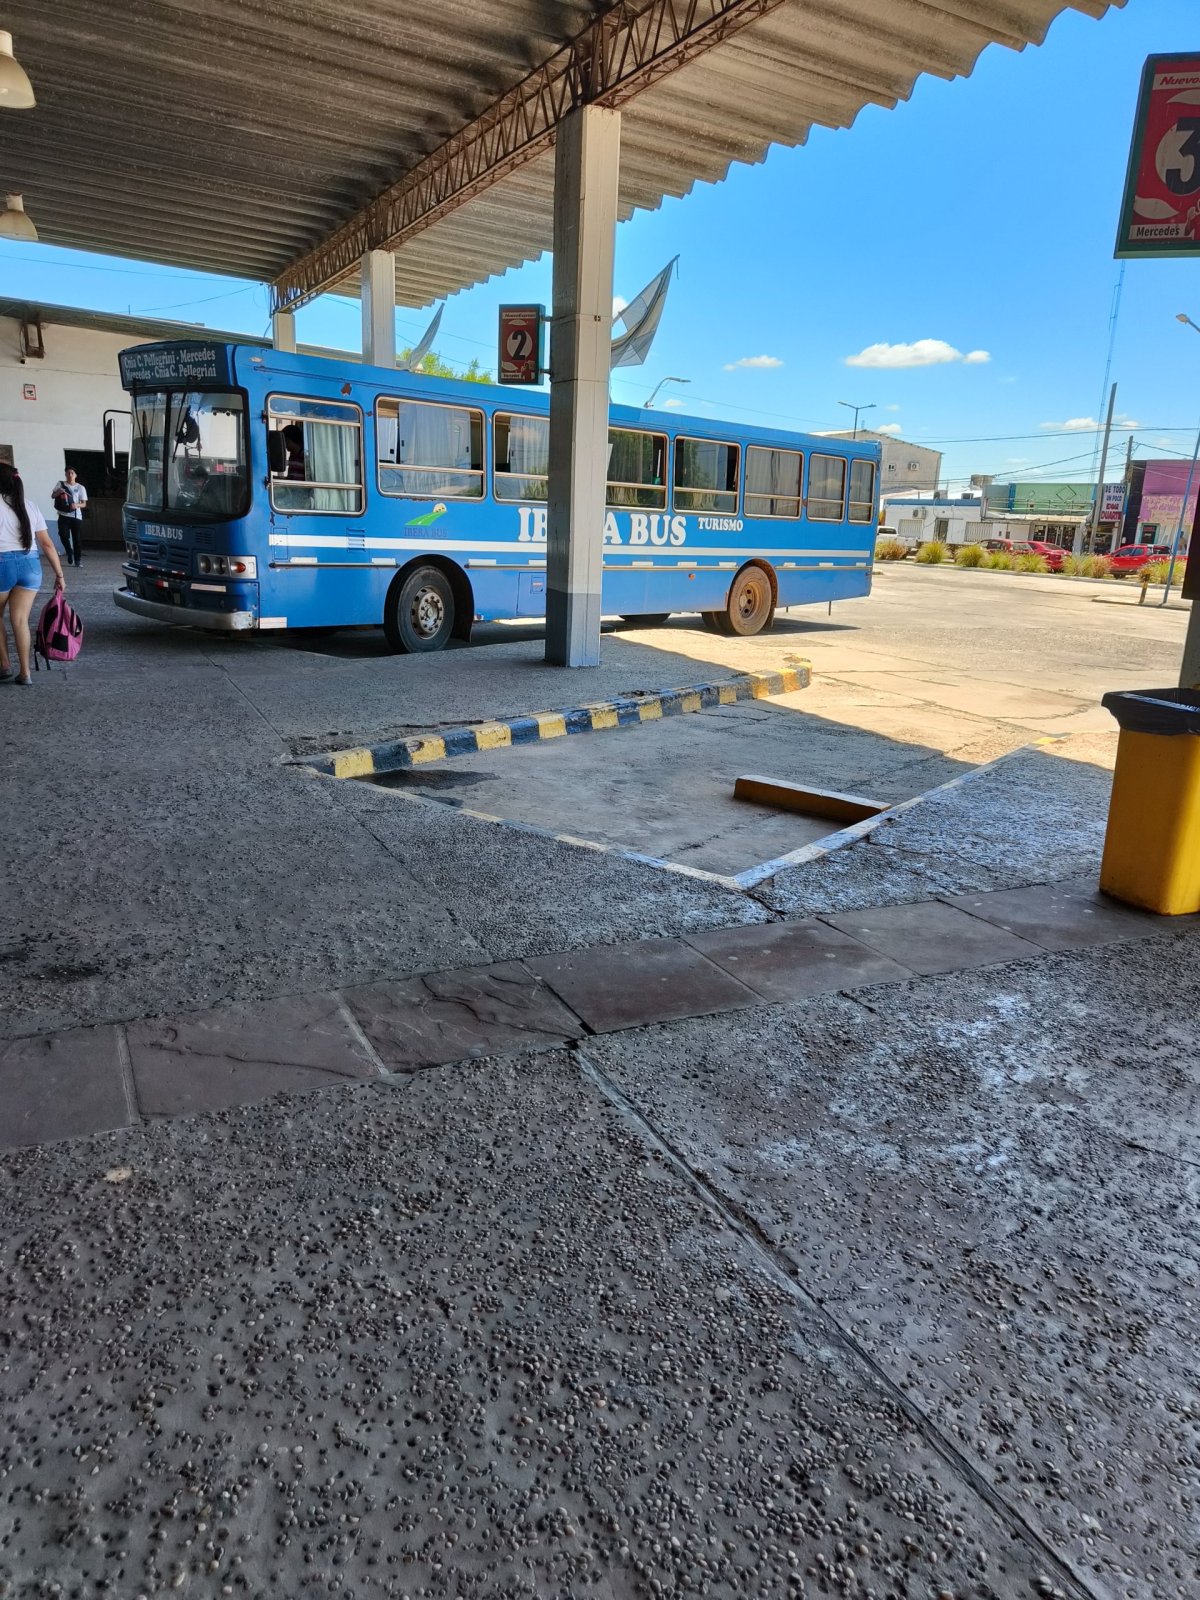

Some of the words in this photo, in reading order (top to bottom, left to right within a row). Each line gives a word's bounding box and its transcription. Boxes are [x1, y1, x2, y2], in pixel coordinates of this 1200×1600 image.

[1165, 117, 1200, 195] 3
[1136, 226, 1180, 237] Mercedes
[512, 330, 527, 360] 2
[179, 348, 216, 363] Mercedes
[178, 364, 217, 380] Pellegrini
[145, 524, 167, 538] IBERA
[167, 527, 183, 540] BUS
[404, 527, 430, 537] IBERA
[432, 528, 448, 538] BUS
[629, 513, 687, 546] BUS
[697, 517, 744, 532] TURISMO
